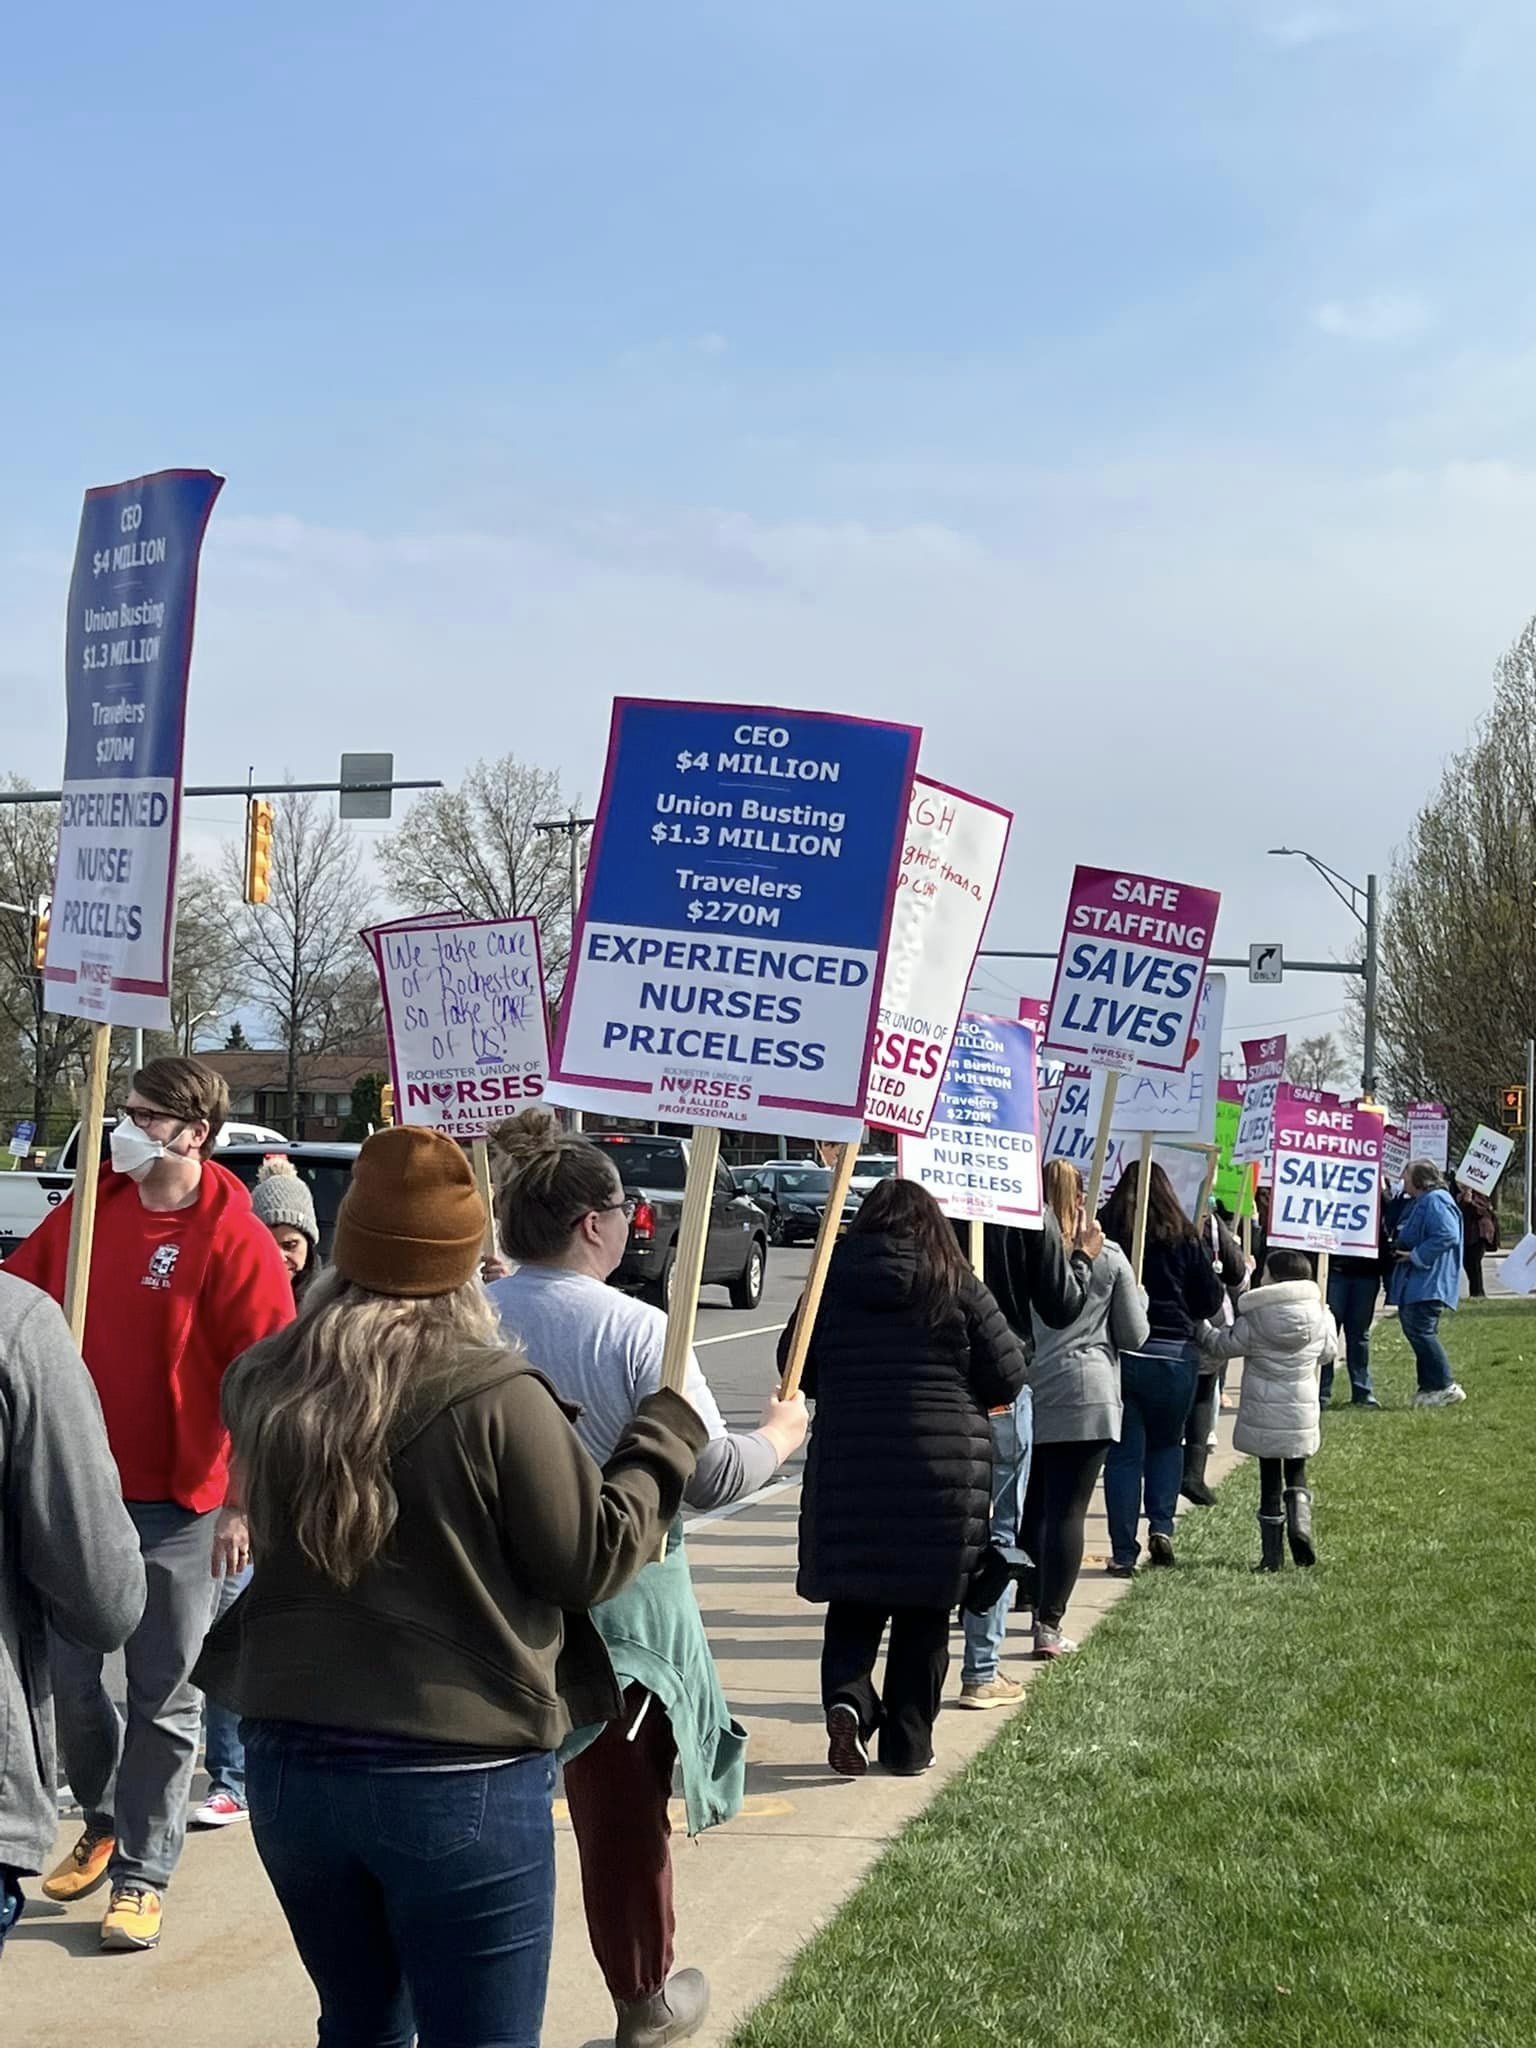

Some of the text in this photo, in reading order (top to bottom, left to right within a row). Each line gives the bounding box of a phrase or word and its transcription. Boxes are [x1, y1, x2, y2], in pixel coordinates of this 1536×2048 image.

[121, 504, 142, 533] CEO
[93, 537, 166, 579] $4 MILLION
[84, 598, 165, 634] Union Busting
[82, 636, 161, 674] $1.3 MILLION
[91, 697, 146, 727] Travelers
[734, 725, 790, 749] CEO
[675, 750, 840, 783] $4 MILLION
[656, 794, 846, 832] Union Busting
[651, 822, 842, 858] $1.3 MILLION
[675, 868, 802, 901] Travelers
[1111, 878, 1180, 911] SAFE
[687, 900, 781, 928] $270M
[1072, 905, 1206, 950] STAFFING
[386, 933, 424, 970] We
[431, 931, 477, 972] take
[587, 933, 869, 987] EXPERIENCED
[1065, 943, 1198, 999] SAVES
[1253, 971, 1277, 980] ONLY
[640, 982, 802, 1024] NURSES
[892, 1013, 931, 1036] UNION
[932, 1024, 949, 1041] OF
[1061, 993, 1182, 1048] LIVES
[603, 1021, 826, 1071] PRICELESS
[406, 1060, 541, 1081] ROCHESTER UNION OF
[663, 1067, 710, 1078] ROCHESTER
[711, 1071, 740, 1082] UNION
[954, 1073, 1013, 1090] MILLION
[962, 1058, 1012, 1077] Busting
[407, 1074, 545, 1106] NURSES
[660, 1075, 753, 1100] NURSES
[869, 1074, 906, 1098] LIED
[1293, 1088, 1323, 1103] SAFE
[441, 1104, 516, 1121] & ALLIED
[658, 1104, 748, 1121] PROFESSIONALS
[679, 1096, 729, 1109] & ALLIED
[939, 1092, 999, 1110] Travelers
[946, 1108, 993, 1123] $270M
[1304, 1108, 1355, 1131] SAFE
[926, 1127, 1034, 1153] PERIENCED
[1053, 1125, 1115, 1161] LIVS
[1279, 1129, 1377, 1157] STAFFING
[1479, 1139, 1498, 1153] FAIR
[933, 1148, 1009, 1170] NURSES
[1466, 1165, 1489, 1180] NOW
[1469, 1148, 1502, 1169] CONTRACT
[921, 1167, 1023, 1194] PRICELESS
[1279, 1157, 1376, 1194] SAVES
[1281, 1195, 1371, 1232] LIVES
